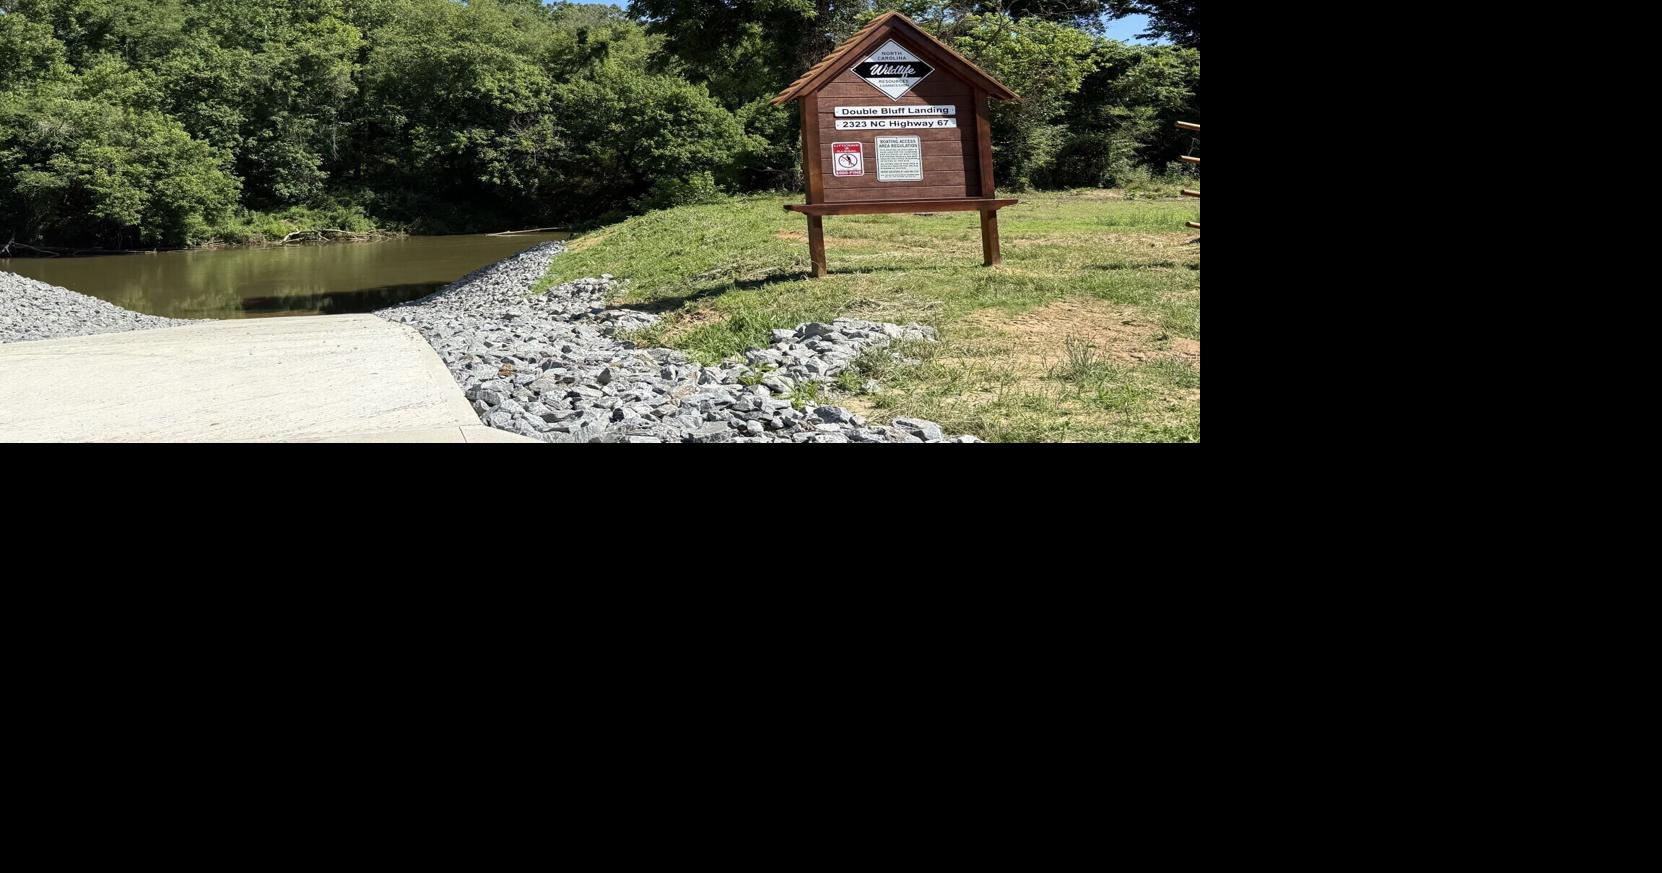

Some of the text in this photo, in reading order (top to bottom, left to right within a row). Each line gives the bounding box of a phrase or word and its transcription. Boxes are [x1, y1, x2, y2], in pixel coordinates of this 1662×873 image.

[869, 63, 916, 78] Wildlife
[881, 107, 905, 115] Bluff
[889, 120, 934, 128] Highway
